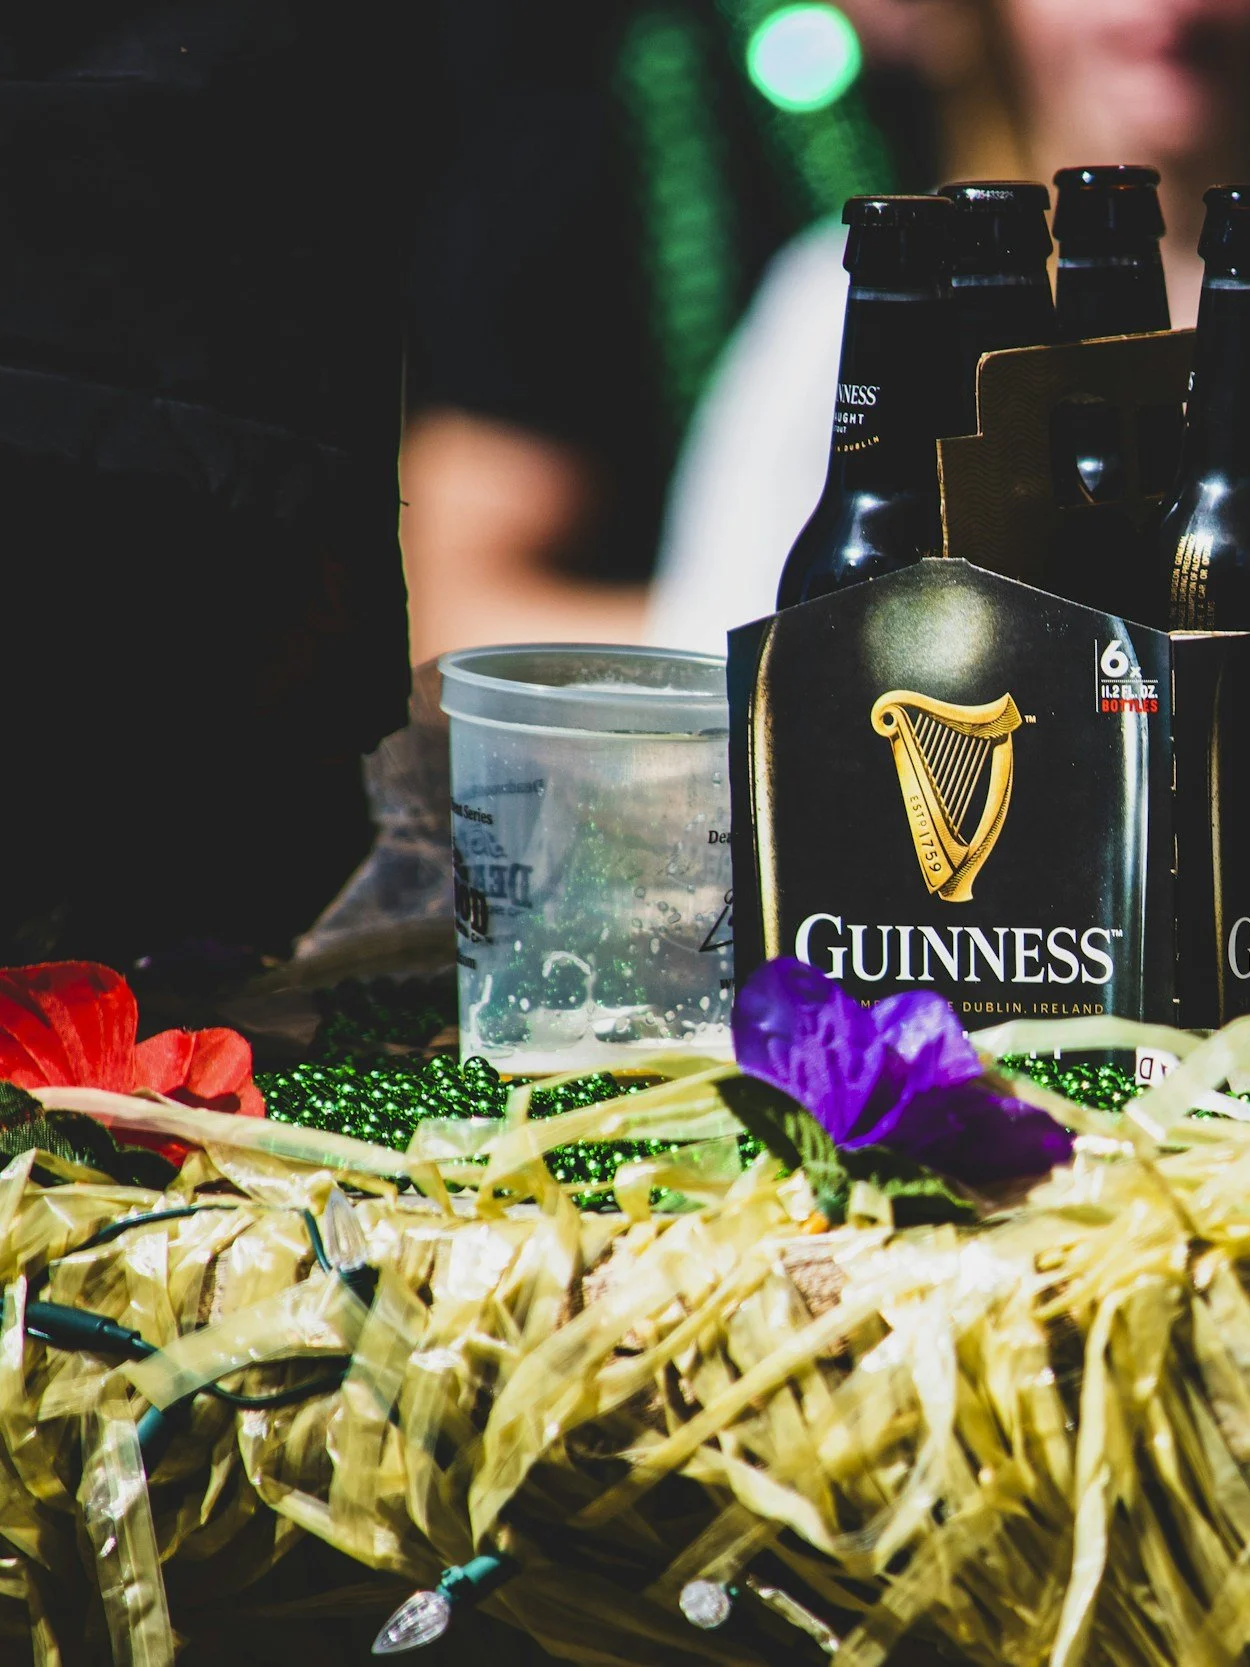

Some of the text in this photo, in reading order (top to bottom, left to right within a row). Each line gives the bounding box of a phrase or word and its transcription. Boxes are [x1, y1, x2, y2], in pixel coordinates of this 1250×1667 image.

[838, 383, 877, 406] NNESS
[835, 412, 864, 424] UGHT
[1200, 568, 1208, 580] OR
[1101, 685, 1120, 698] 11.2
[1101, 699, 1159, 713] BOTTLES
[463, 804, 494, 825] Series
[919, 832, 942, 873] 1759
[795, 913, 1114, 985] GUINNESS
[1032, 1003, 1105, 1015] IRELAND
